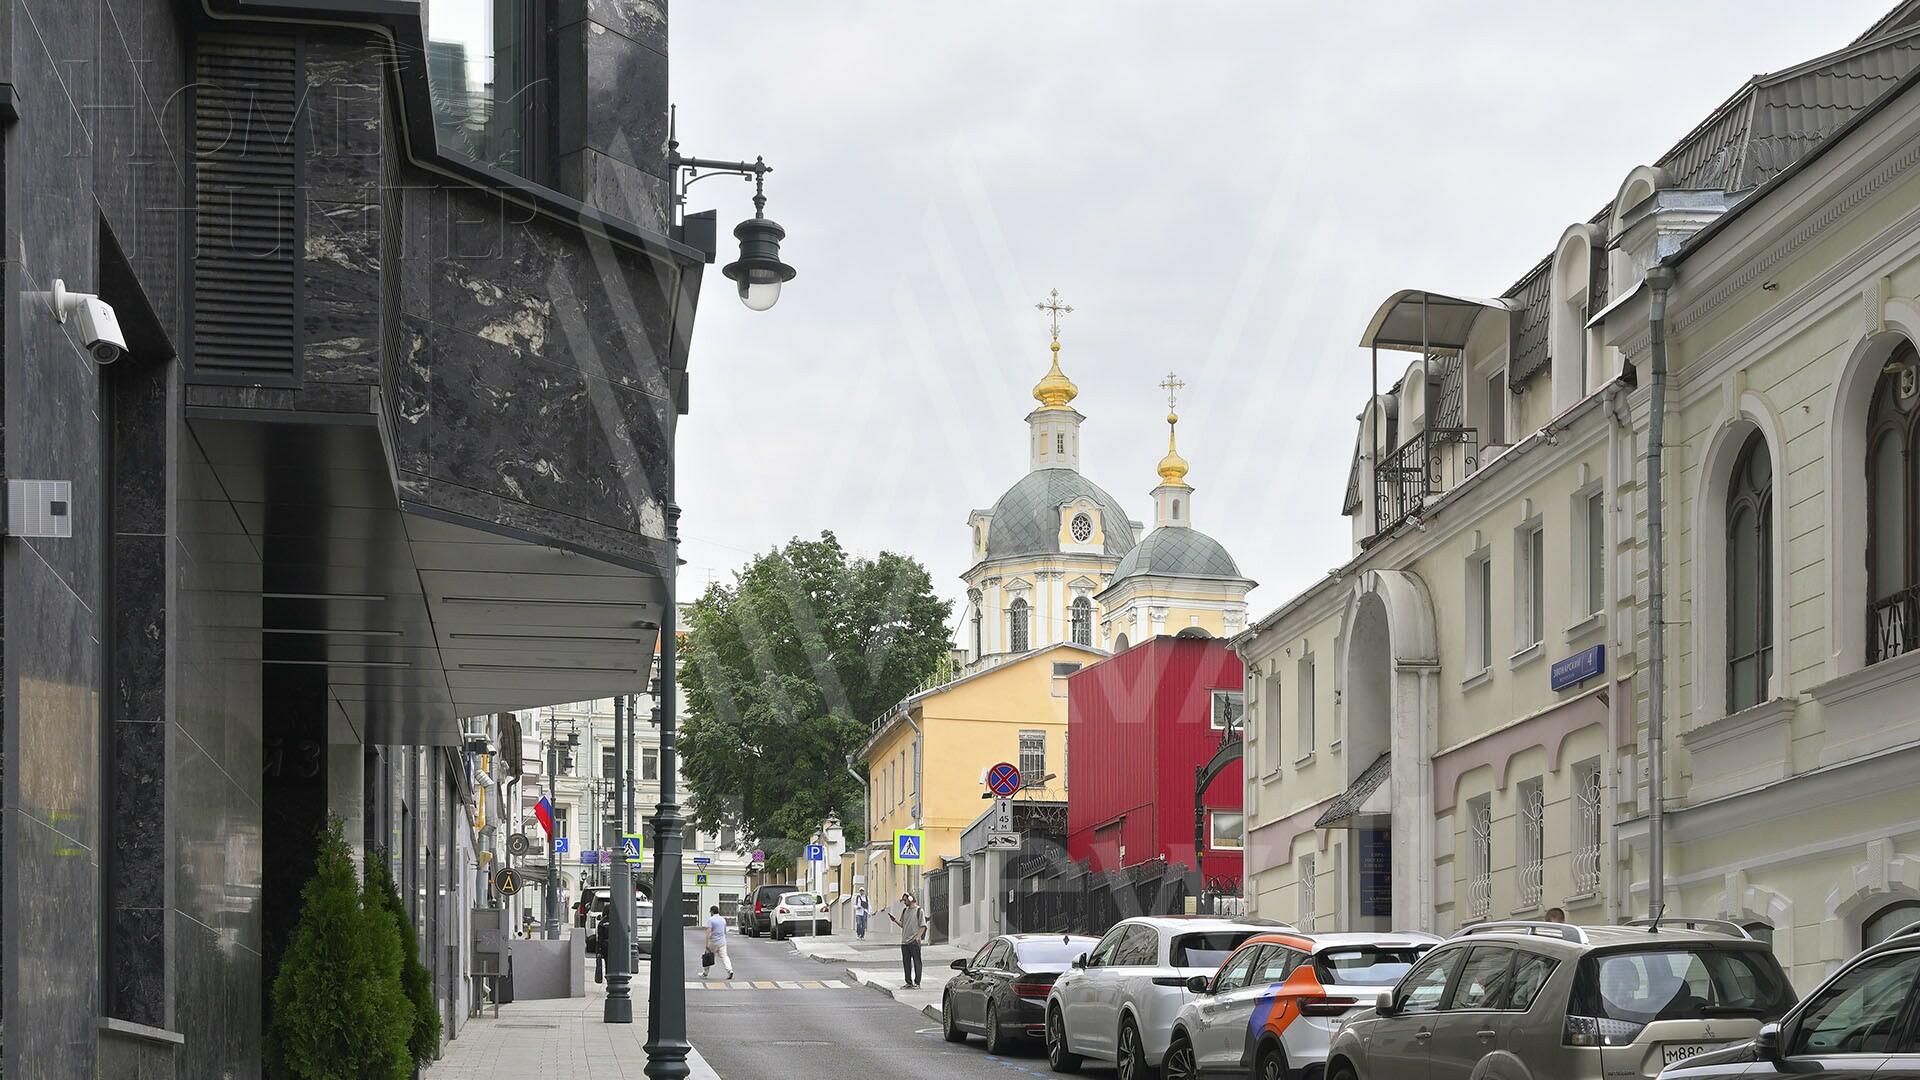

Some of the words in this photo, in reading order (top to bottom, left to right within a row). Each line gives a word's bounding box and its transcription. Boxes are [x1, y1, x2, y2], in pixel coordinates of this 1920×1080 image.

[1587, 653, 1593, 666] 4
[999, 815, 1009, 823] 45
[555, 839, 563, 851] P
[811, 846, 820, 859] P
